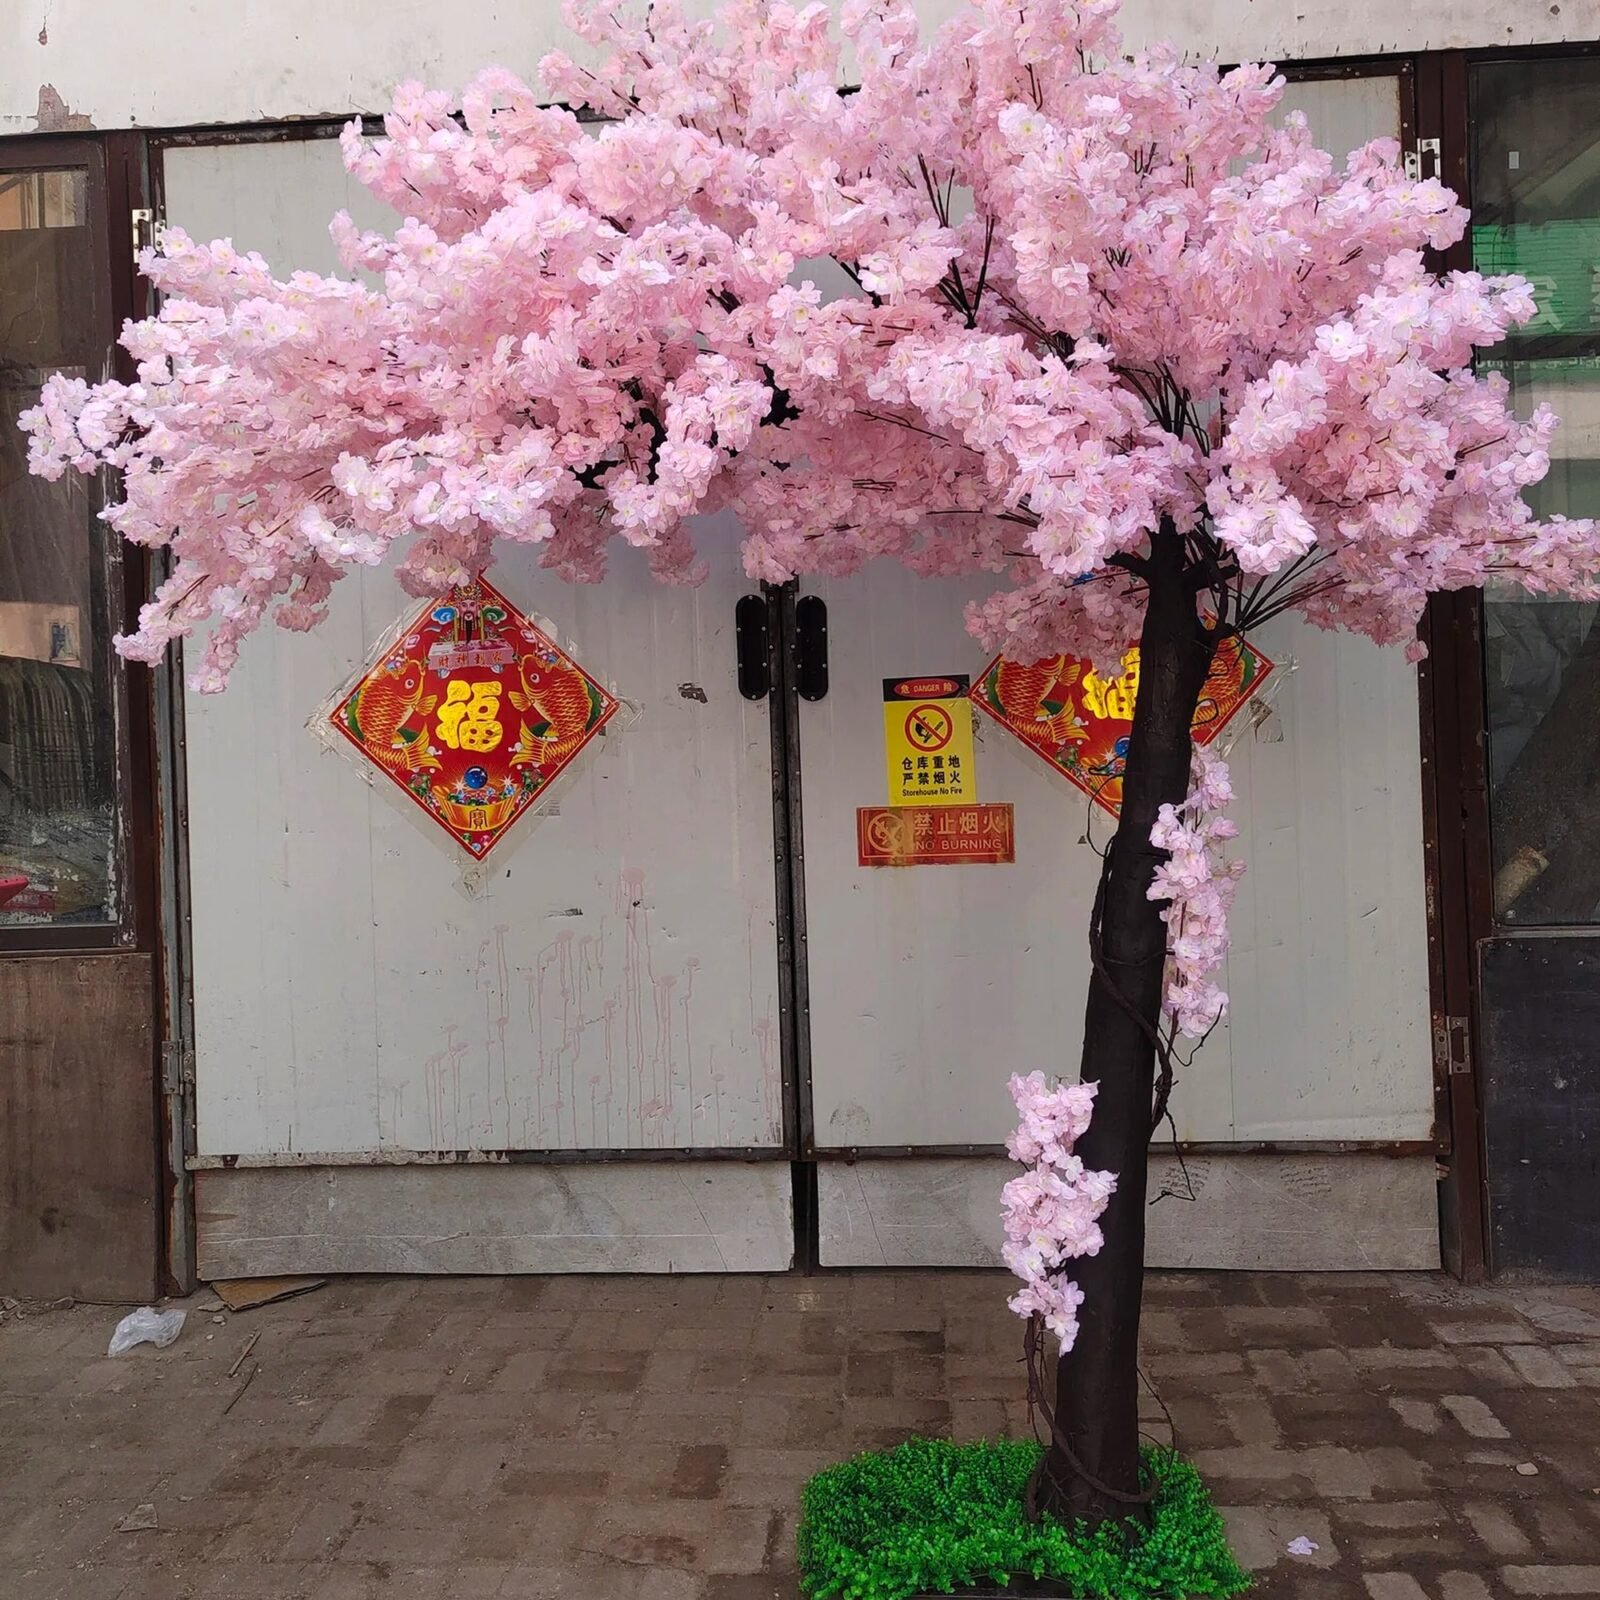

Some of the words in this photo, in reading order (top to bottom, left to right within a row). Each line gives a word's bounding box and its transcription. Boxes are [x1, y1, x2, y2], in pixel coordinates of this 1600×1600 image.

[900, 684, 910, 695] 危
[913, 684, 940, 692] DANGER
[435, 680, 504, 753] 福
[902, 755, 961, 770] 仓库重地
[902, 771, 961, 786] 严禁烟火
[902, 789, 938, 797] Storehouse
[939, 787, 949, 795] No
[950, 786, 963, 795] Fire
[913, 811, 1001, 836] 禁止烟火
[915, 840, 935, 850] NO
[941, 839, 1001, 850] BURNING
